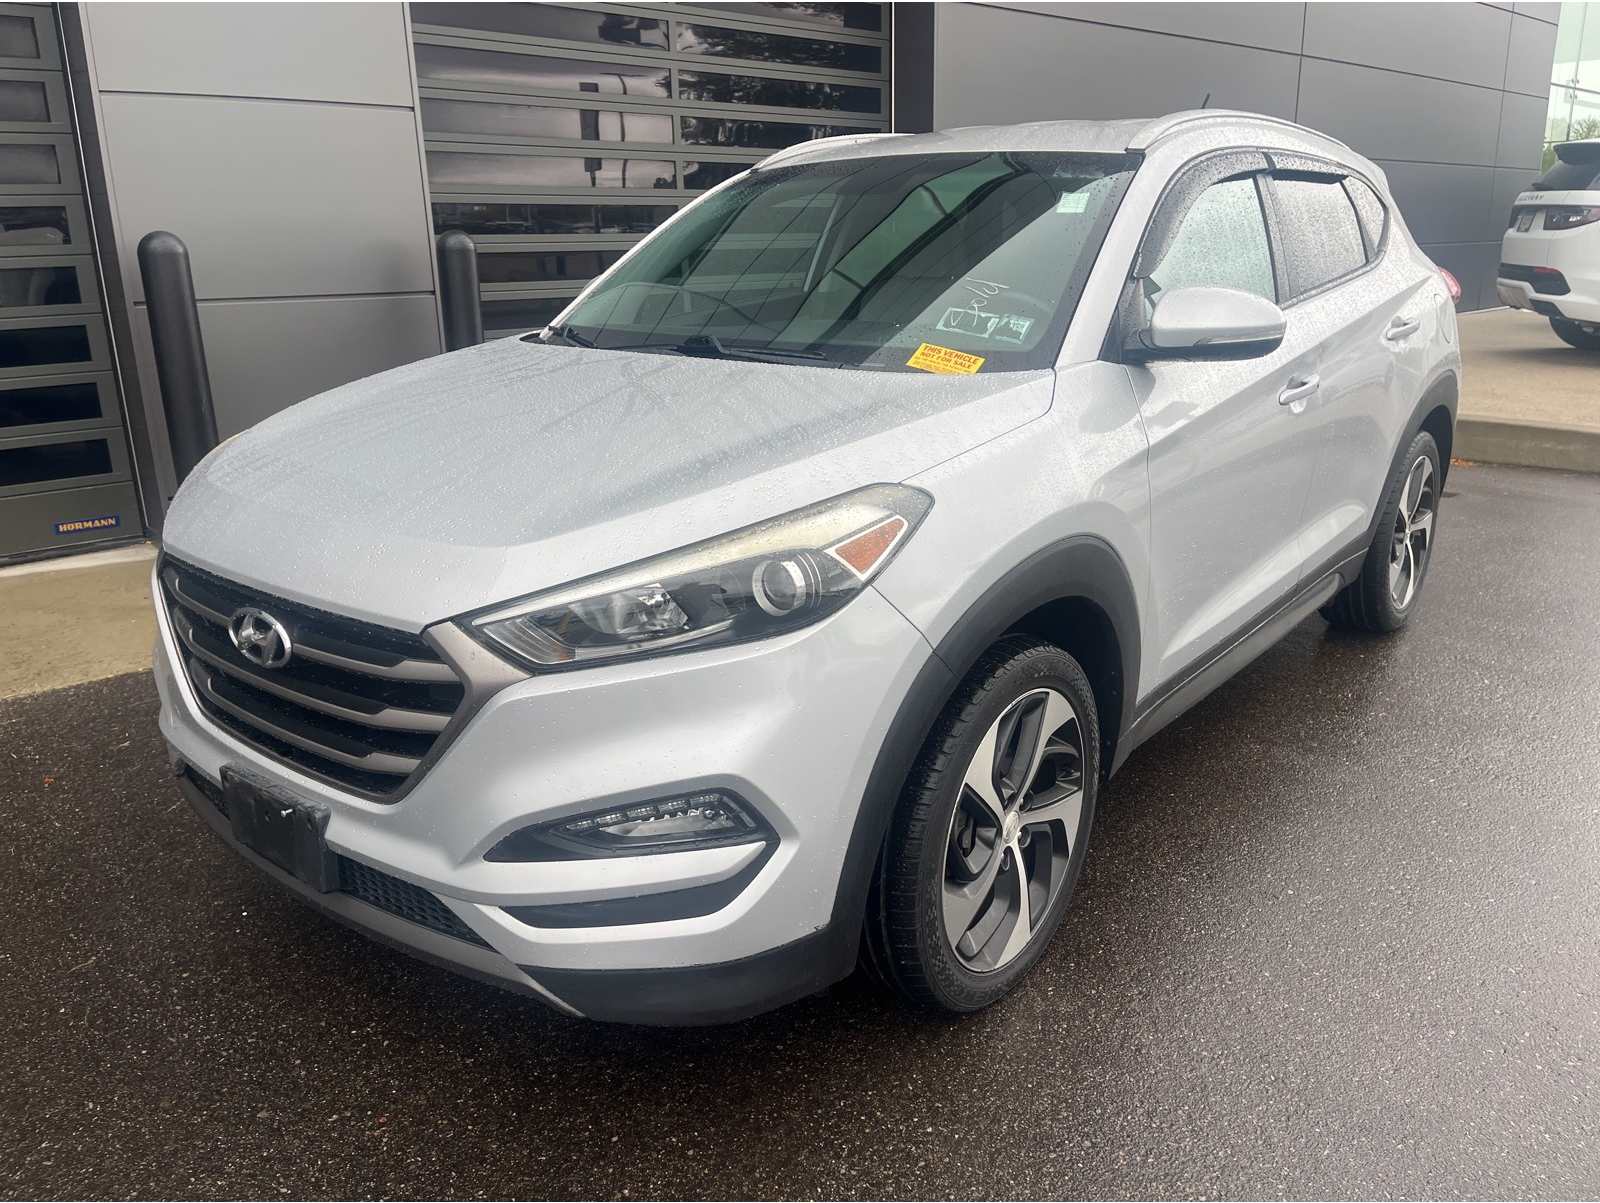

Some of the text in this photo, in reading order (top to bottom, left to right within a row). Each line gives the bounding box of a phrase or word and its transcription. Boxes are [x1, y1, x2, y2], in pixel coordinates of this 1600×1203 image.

[920, 352, 937, 360] NOT
[936, 355, 951, 363] FOR
[953, 360, 973, 369] SALE
[923, 345, 943, 355] THIS
[943, 350, 978, 365] VEHICLE
